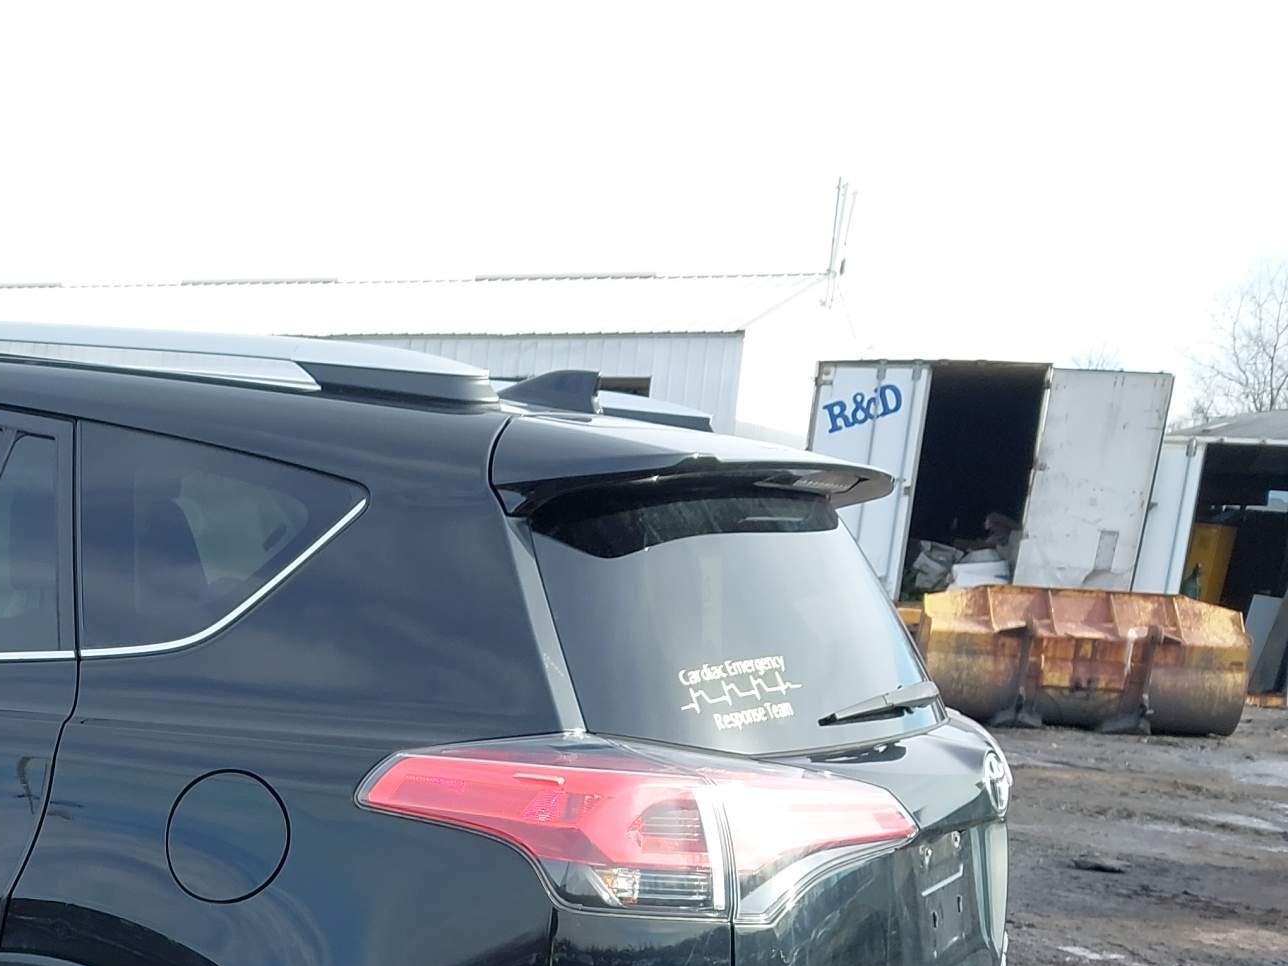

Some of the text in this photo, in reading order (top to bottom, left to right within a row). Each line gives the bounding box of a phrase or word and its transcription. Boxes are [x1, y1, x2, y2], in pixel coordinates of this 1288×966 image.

[822, 384, 903, 433] R&D
[678, 655, 785, 686] Cardiac Emergency
[713, 701, 794, 731] Response Team
